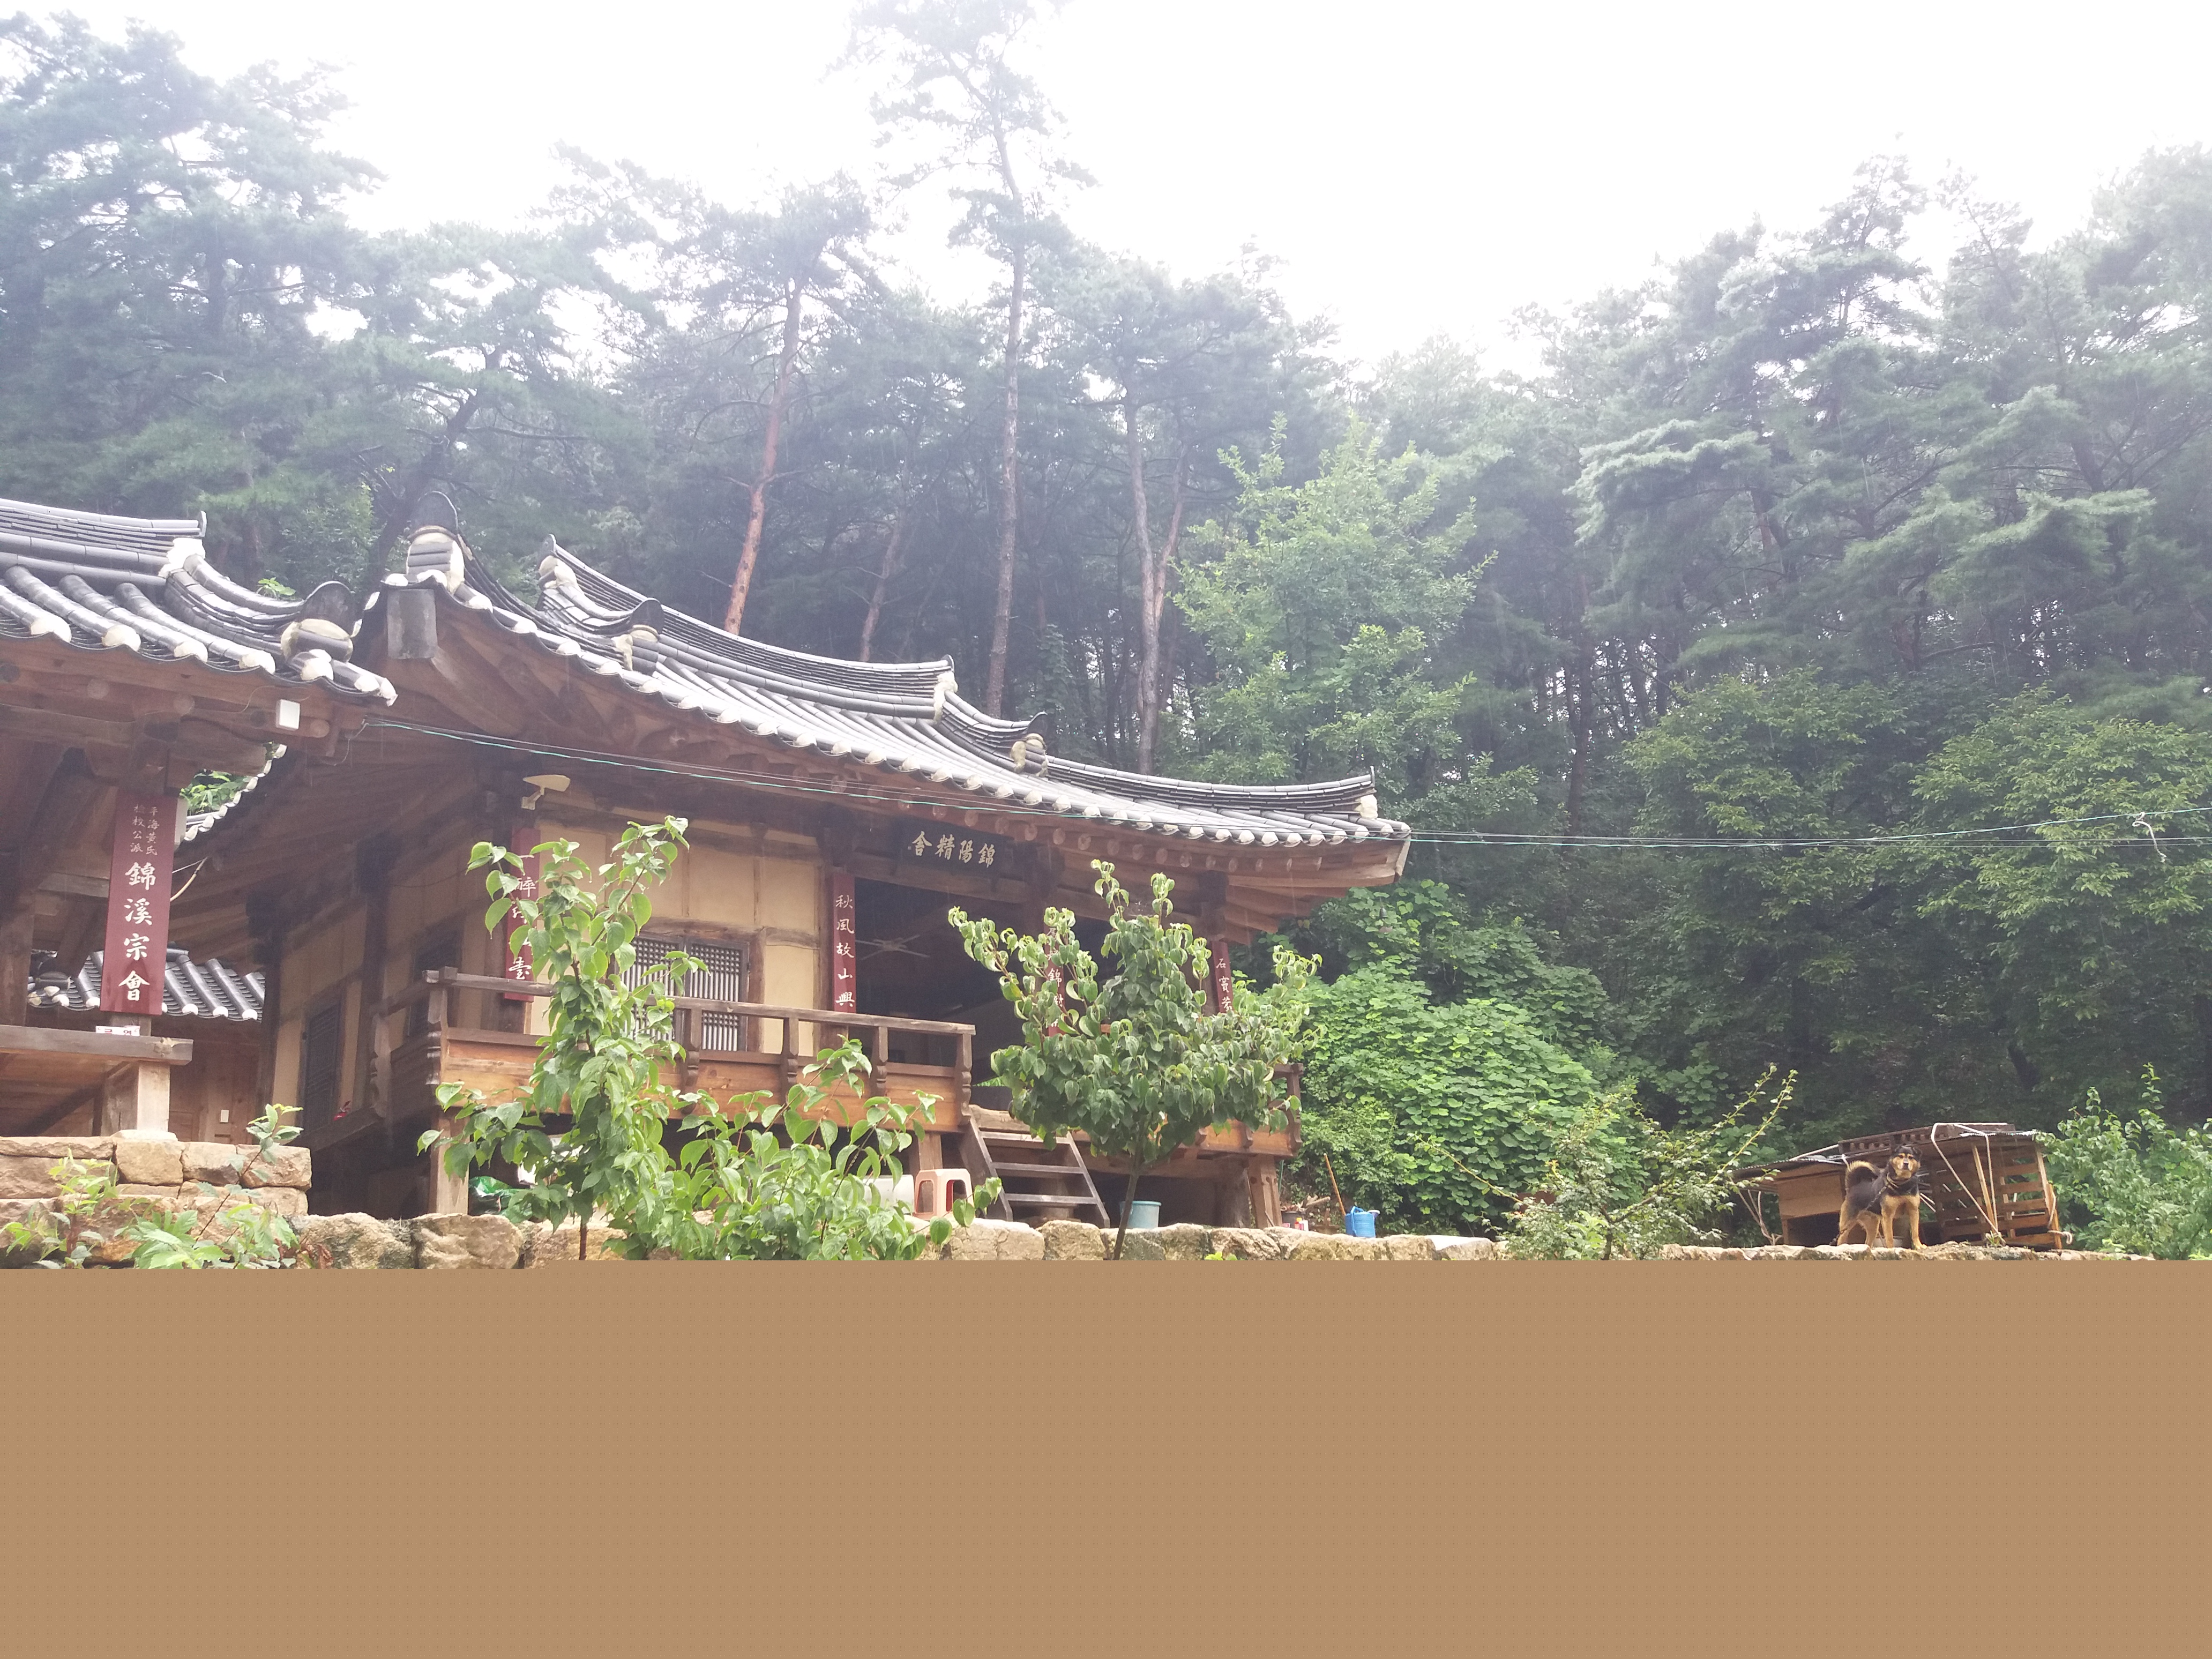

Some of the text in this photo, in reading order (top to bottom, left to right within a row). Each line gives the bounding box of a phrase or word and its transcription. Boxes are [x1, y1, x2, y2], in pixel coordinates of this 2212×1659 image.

[911, 831, 996, 868] 錦陽精舍
[118, 861, 156, 1002] 錦溪宗會
[835, 894, 855, 1007] 秋風故山興
